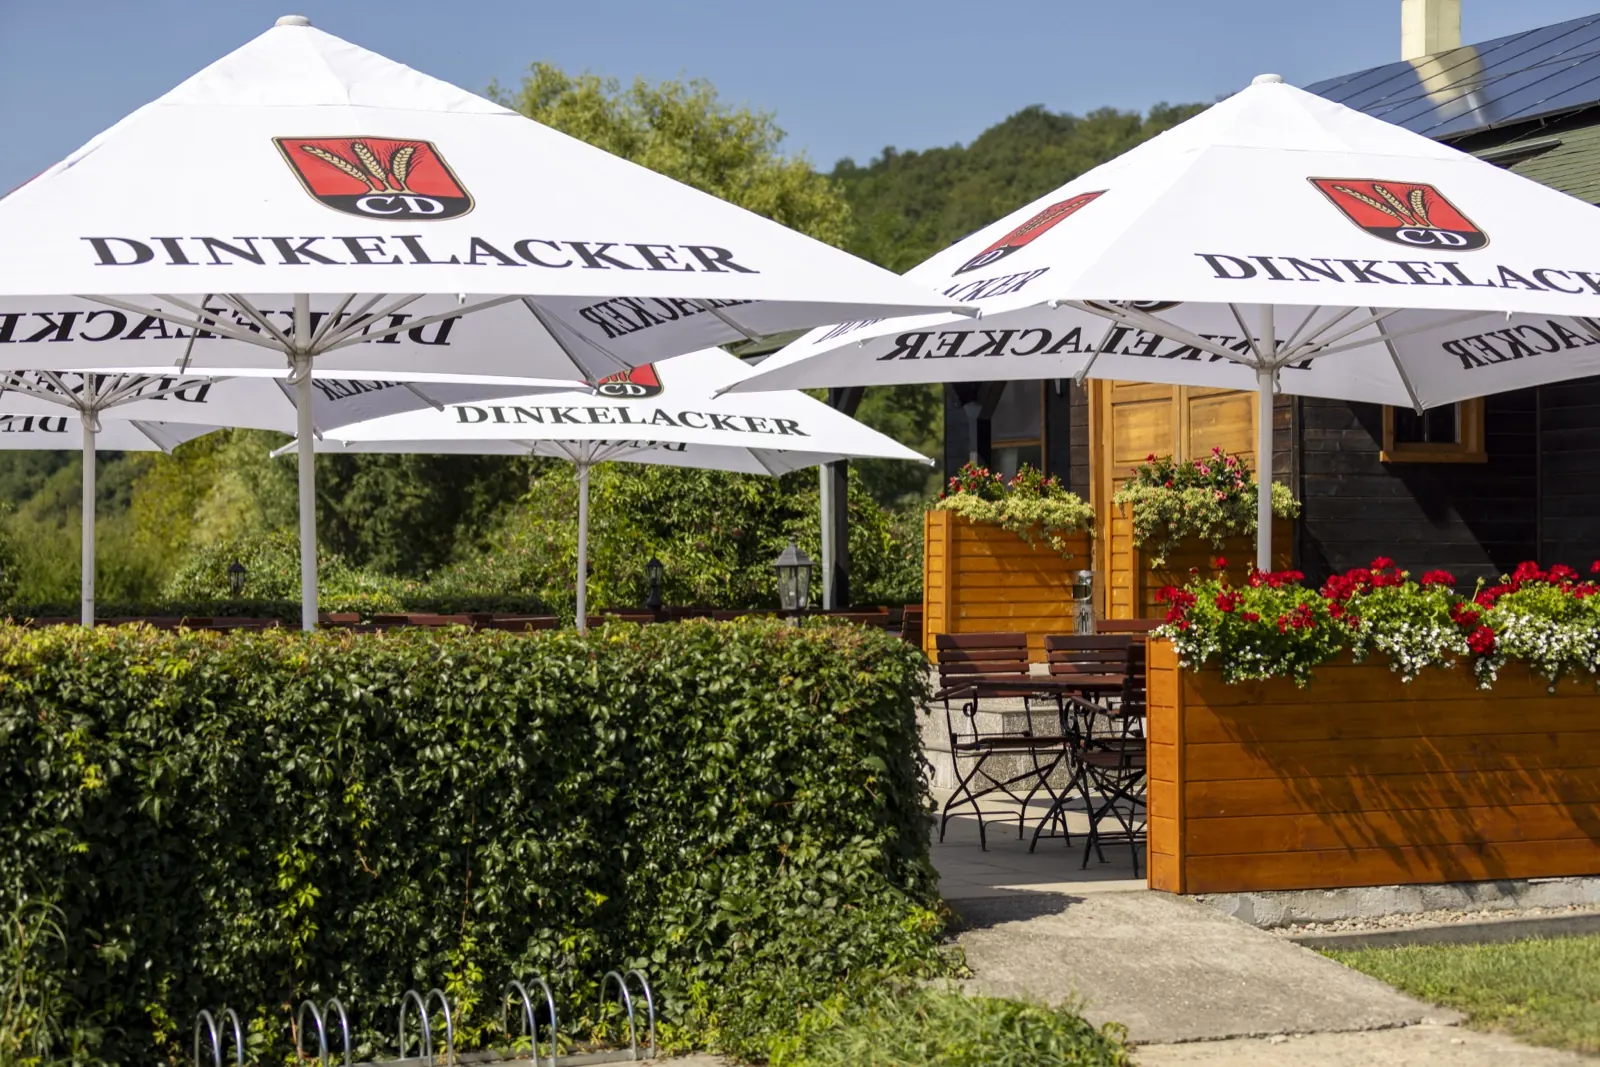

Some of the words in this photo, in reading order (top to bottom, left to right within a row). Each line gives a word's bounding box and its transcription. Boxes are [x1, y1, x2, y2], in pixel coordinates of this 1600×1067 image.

[356, 195, 444, 214] CD
[1396, 228, 1467, 247] CD
[80, 235, 761, 273] DINKELACKER
[598, 383, 647, 396] CD
[455, 405, 812, 437] DINKELACKER
